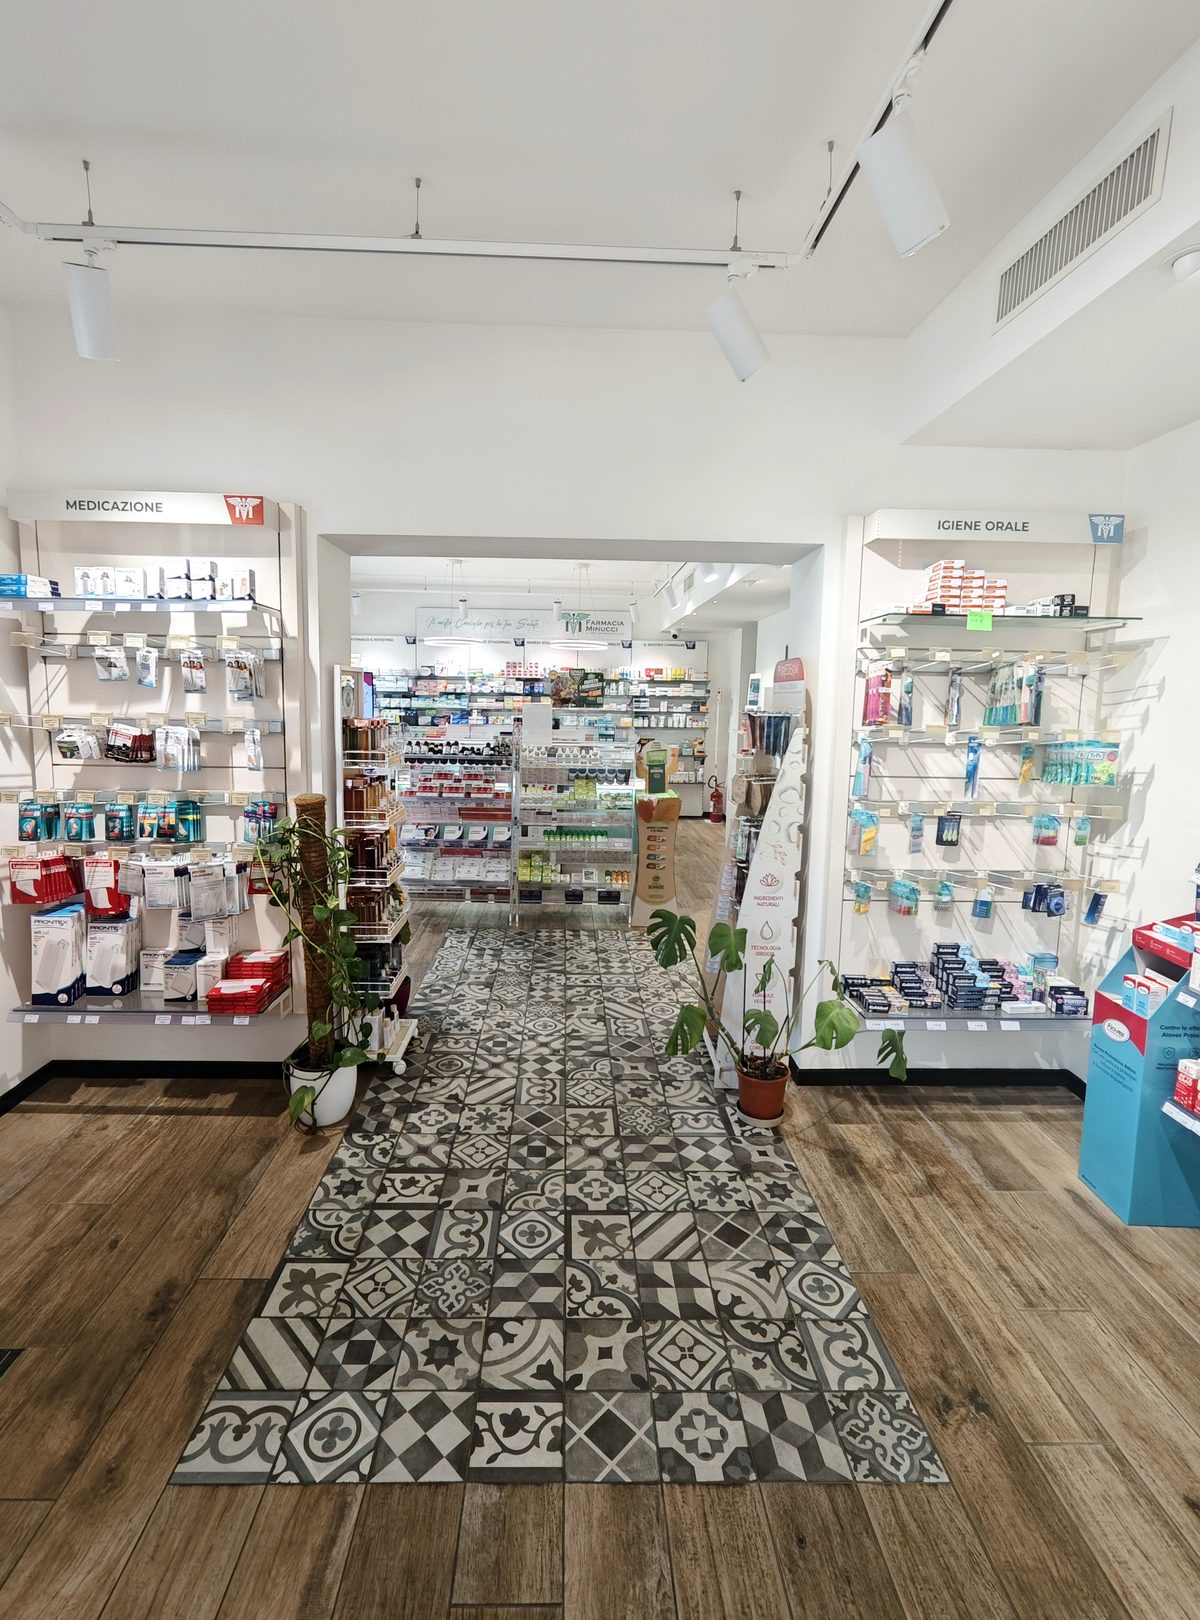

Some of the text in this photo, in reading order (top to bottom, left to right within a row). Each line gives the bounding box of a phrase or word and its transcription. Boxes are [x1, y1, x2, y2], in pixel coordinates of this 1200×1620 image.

[65, 499, 163, 513] MEDICAZIONE
[937, 520, 1030, 532] IGIENE ORALE
[585, 619, 625, 627] FARMACIA
[585, 625, 619, 633] MINUCCI
[33, 919, 69, 927] PRONTEX
